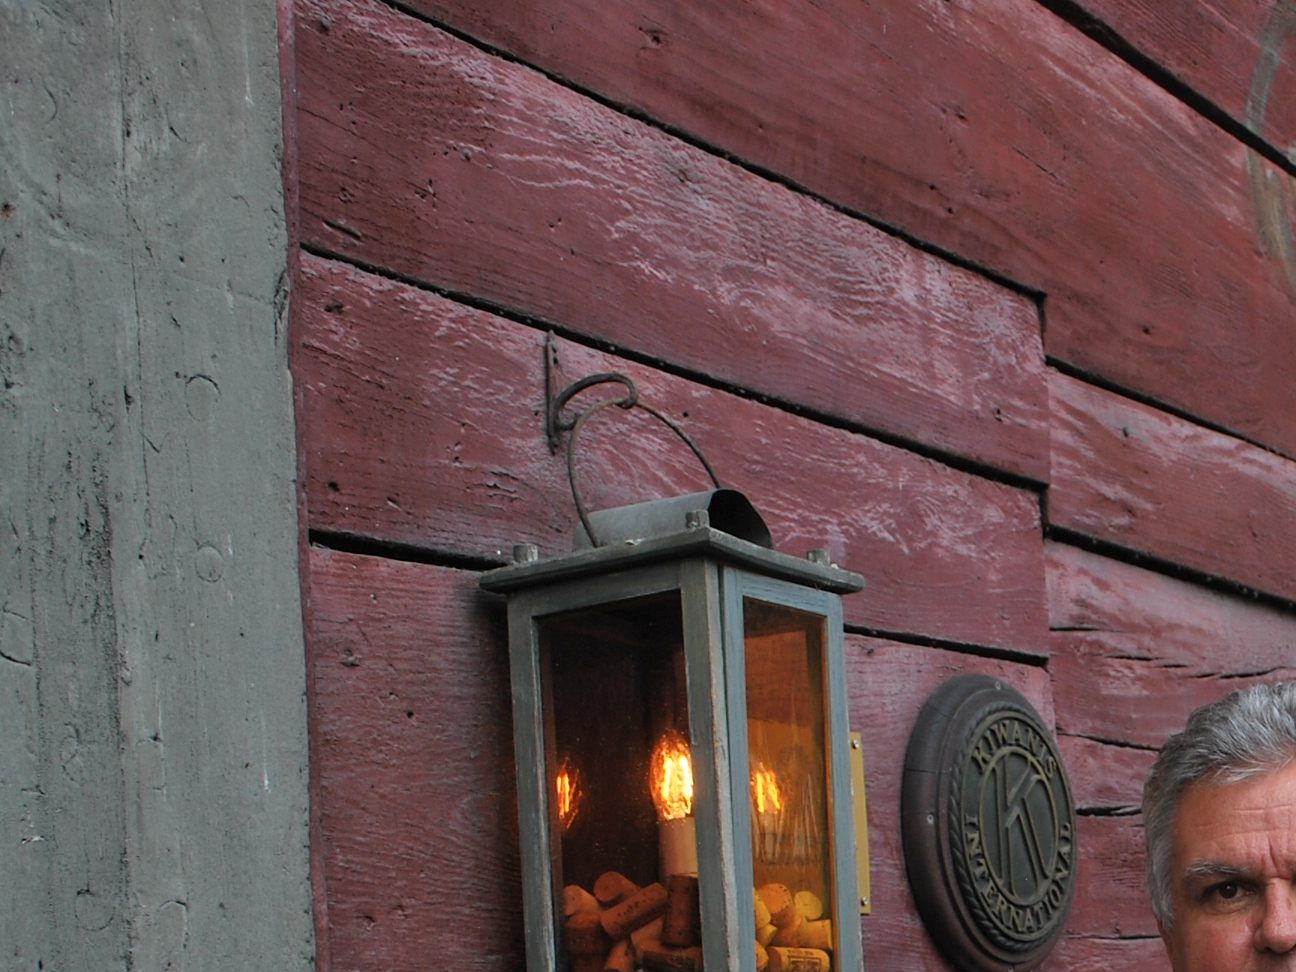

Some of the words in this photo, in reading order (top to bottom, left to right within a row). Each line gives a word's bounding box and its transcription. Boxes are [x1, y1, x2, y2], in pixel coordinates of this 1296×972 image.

[973, 720, 1057, 779] KIWANIS
[966, 814, 1071, 933] INTERNATIONAL
[992, 752, 1053, 898] K
